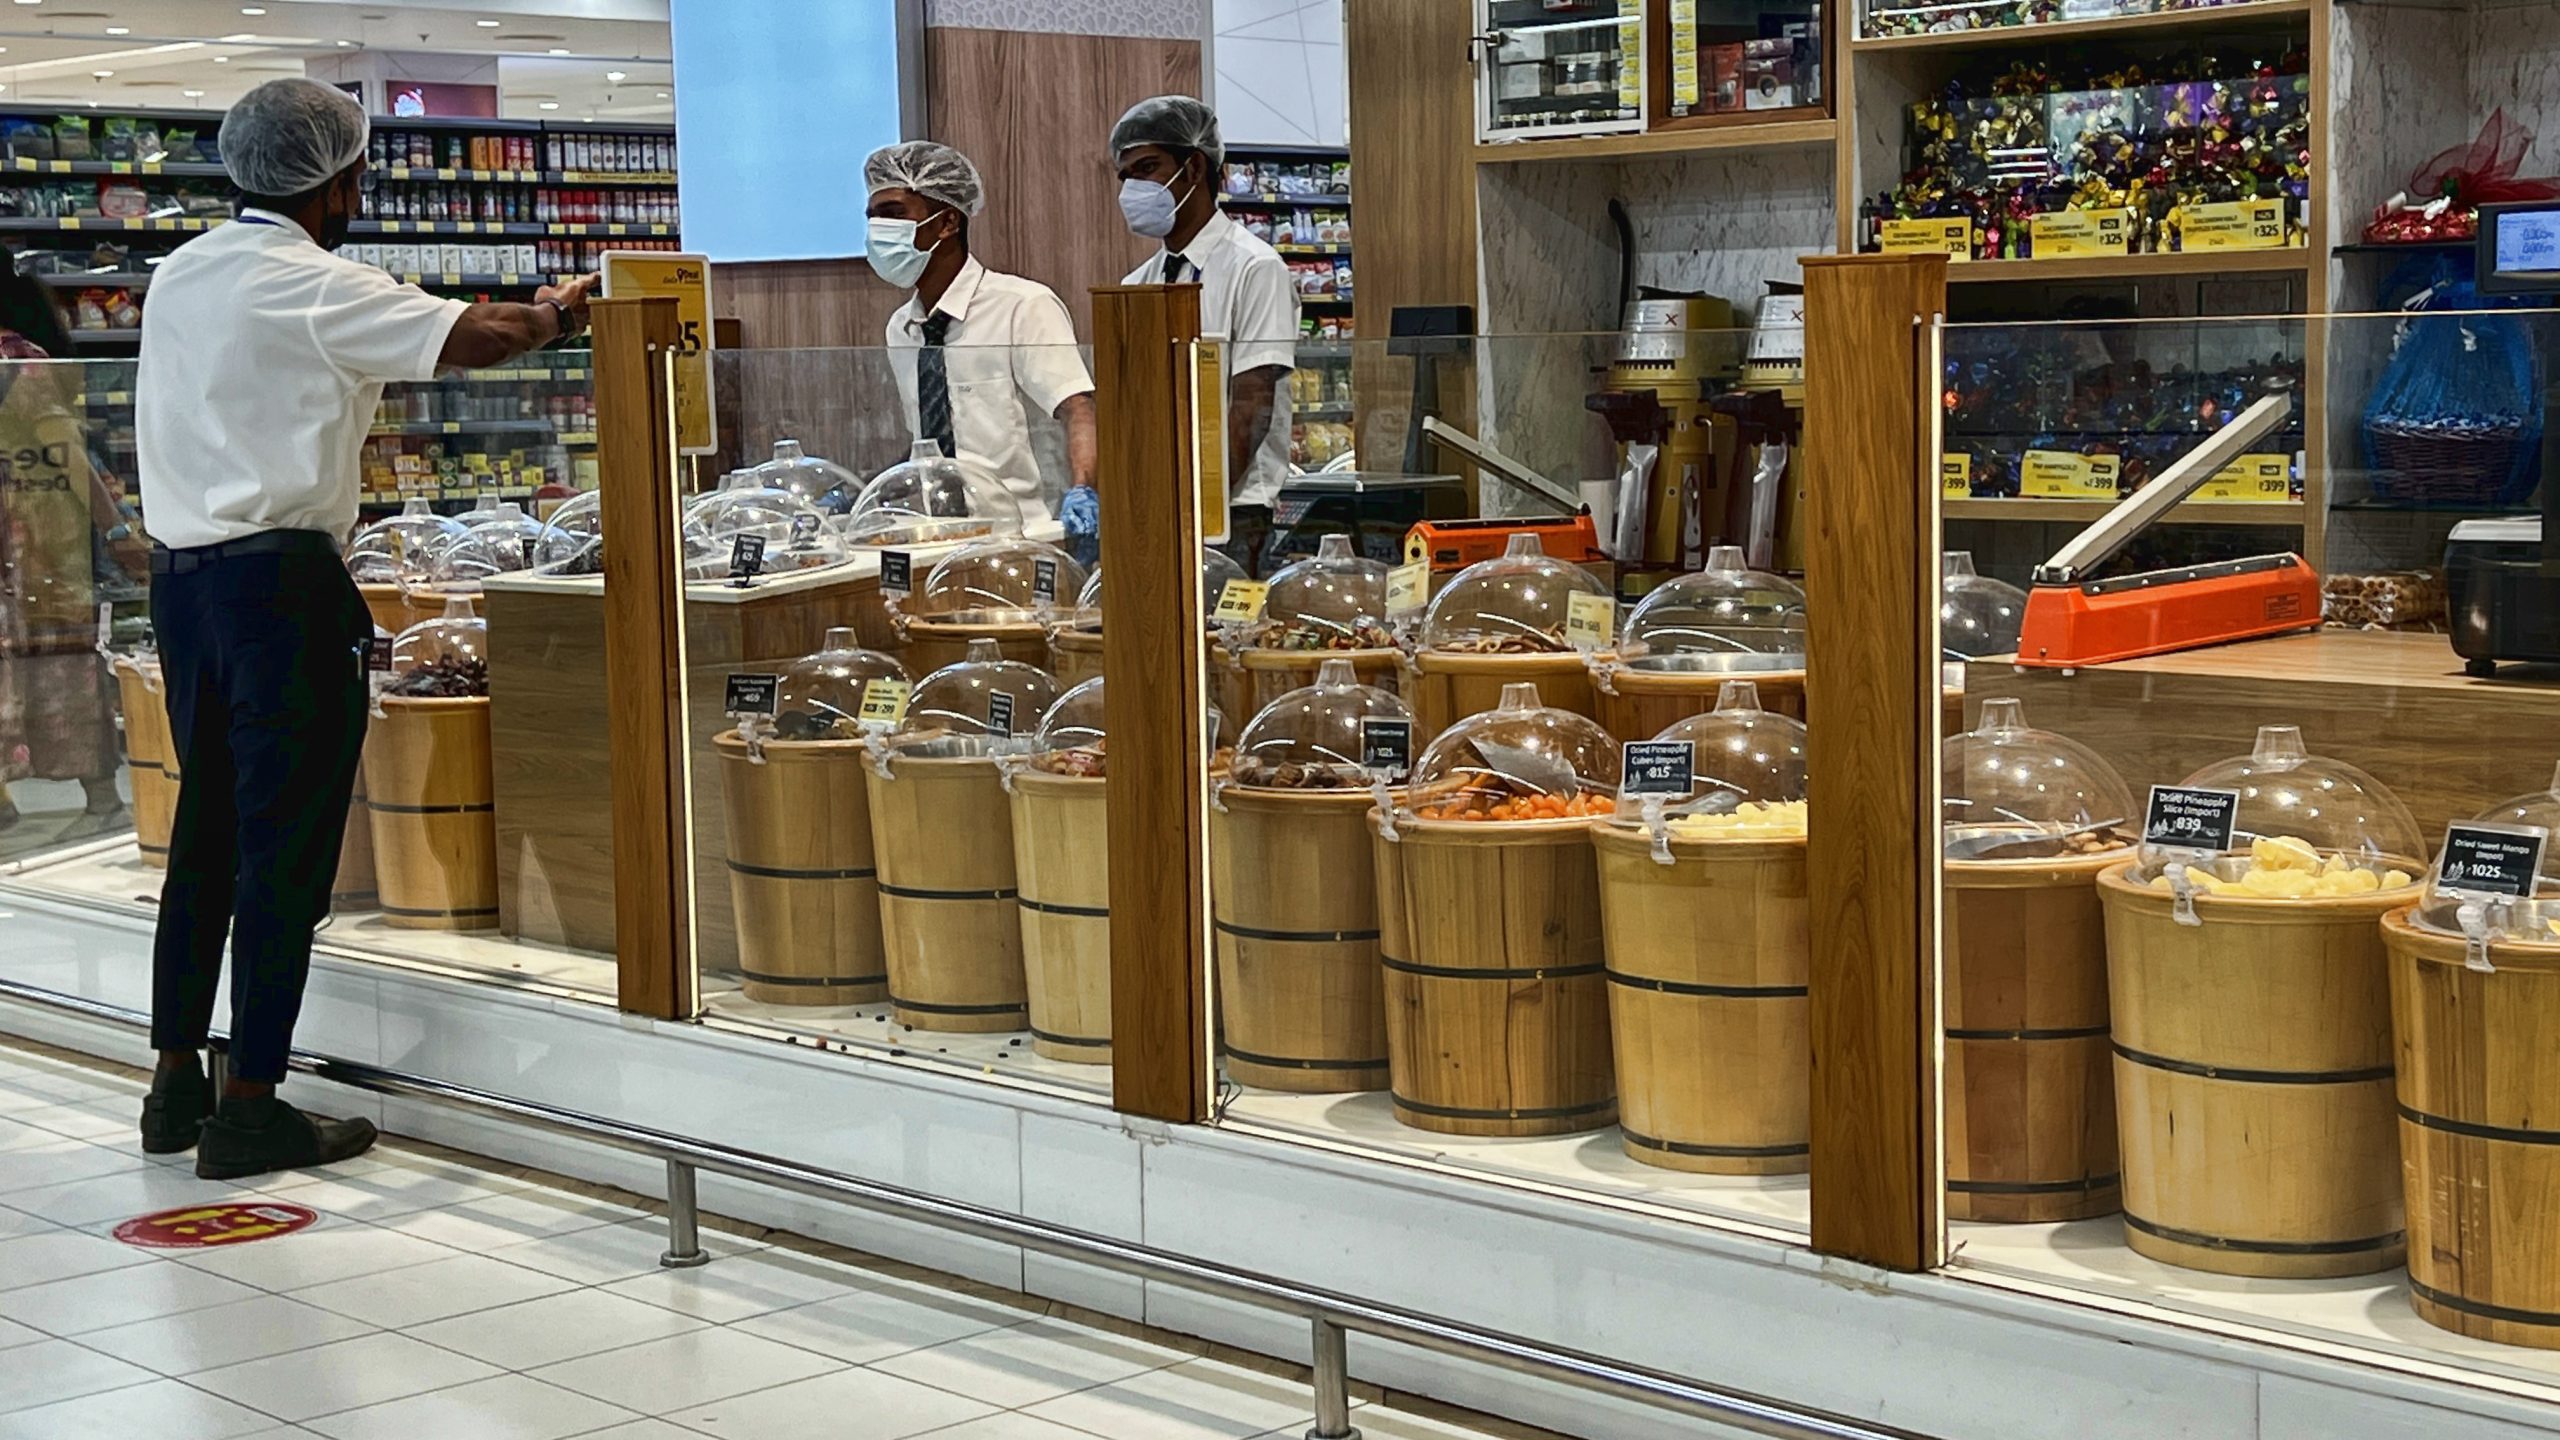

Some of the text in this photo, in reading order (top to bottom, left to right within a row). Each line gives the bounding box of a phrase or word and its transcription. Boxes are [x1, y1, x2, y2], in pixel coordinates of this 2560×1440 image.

[1630, 745, 1650, 754] Dried
[1631, 756, 1654, 765] Cubes
[2184, 795, 2228, 808] Pineapple
[2163, 803, 2221, 818] Slice (Import)
[2454, 839, 2476, 849] Dried
[2502, 843, 2531, 855] Mango
